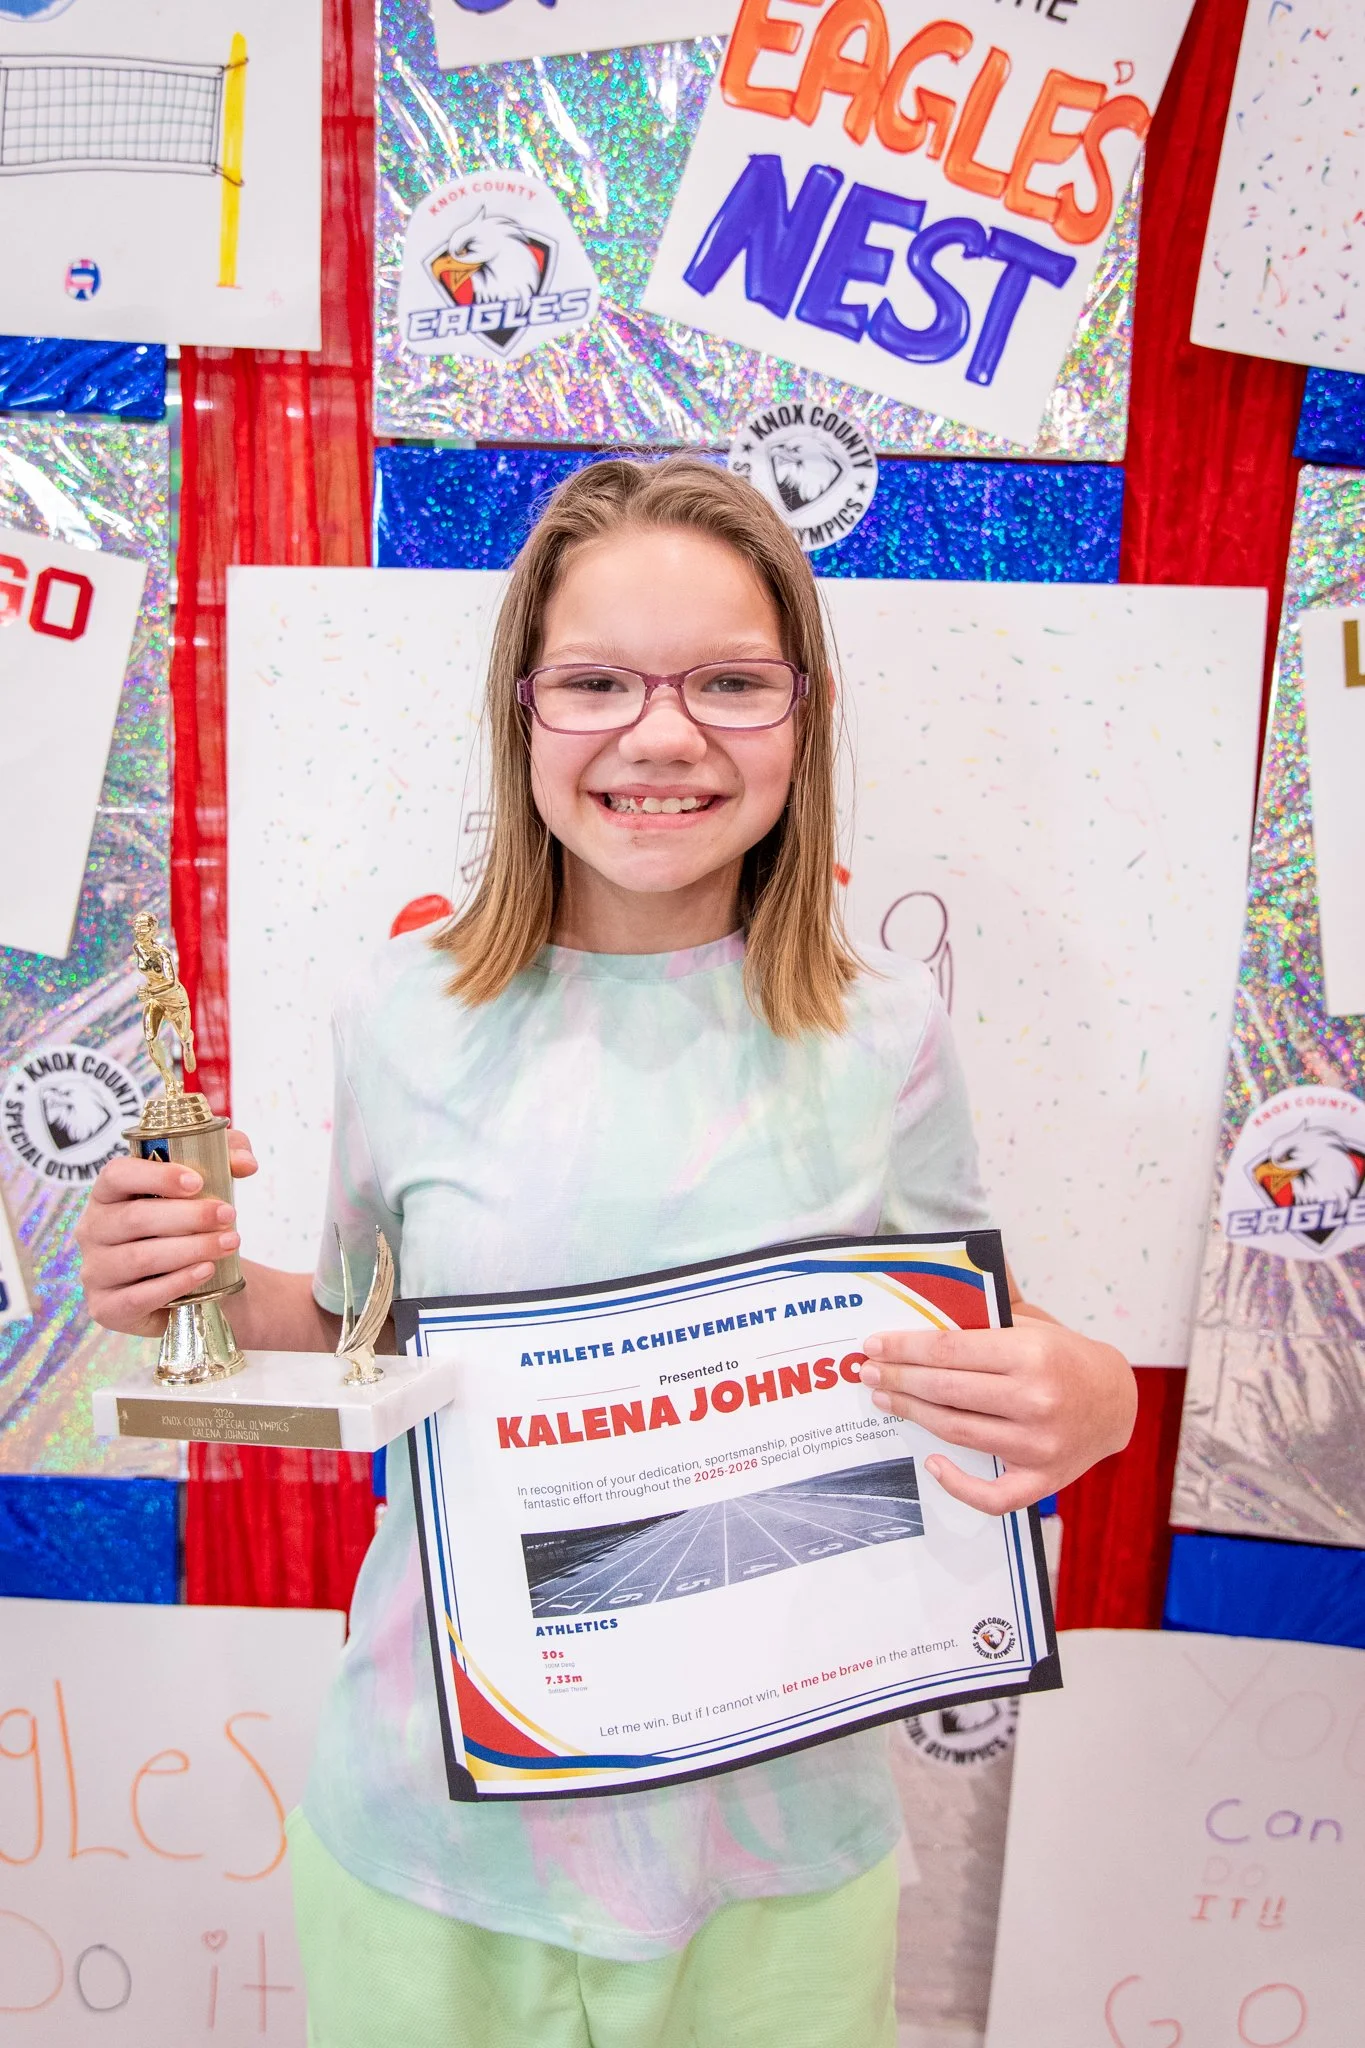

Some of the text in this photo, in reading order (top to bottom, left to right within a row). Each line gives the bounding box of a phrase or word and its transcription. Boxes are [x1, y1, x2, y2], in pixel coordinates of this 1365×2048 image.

[428, 181, 537, 217] KNOX COUNTY
[682, 153, 1077, 387] NEST
[407, 288, 592, 342] EAGLES
[750, 404, 873, 469] KNOX COUNTY
[797, 498, 864, 545] YMPICS
[24, 1052, 141, 1118] KNOX COUNTY
[5, 1100, 44, 1168] SPECIAL
[1254, 1097, 1358, 1128] KNOX COUNTY
[520, 1293, 863, 1367] ATHLETE ACHIEVEMENT AWARD
[659, 1360, 739, 1385] Presented to
[213, 1407, 234, 1418] 2026
[496, 1352, 870, 1449] KALENA JOHNSO
[161, 1416, 289, 1433] KNOX COUNTY SPECIAL OLYMPICS
[192, 1428, 260, 1441] KALENA JOHNSON
[518, 1486, 528, 1496] In
[530, 1480, 594, 1496] recognition
[596, 1476, 609, 1488] of
[610, 1473, 637, 1488] your
[638, 1459, 702, 1480] dedication,
[704, 1438, 788, 1467] sportsmanship,
[790, 1426, 833, 1447] positive
[835, 1416, 880, 1434] attitude,
[523, 1428, 899, 1510] fantastic effort throughout the 2025-2026 Special Olympics Season.
[536, 1618, 619, 1636] ATHLETICS
[972, 1617, 1013, 1635] KNOX COUNTY
[972, 1638, 1016, 1660] SPECIAL OLYMPICS
[542, 1650, 565, 1660] 30s
[545, 1675, 583, 1684] 7.33m
[600, 1725, 619, 1737] Let
[622, 1722, 641, 1734] me
[644, 1717, 669, 1730] win.
[672, 1711, 692, 1725] But
[695, 1707, 703, 1719] if
[712, 1695, 754, 1715] cannot
[756, 1688, 780, 1702] win,
[782, 1680, 798, 1694] let
[800, 1676, 820, 1689] me
[821, 1671, 837, 1683] be
[838, 1657, 874, 1676] brave
[876, 1655, 887, 1666] in
[889, 1649, 908, 1663] the
[910, 1638, 959, 1656] attempt.
[1104, 1974, 1309, 2048] GO
